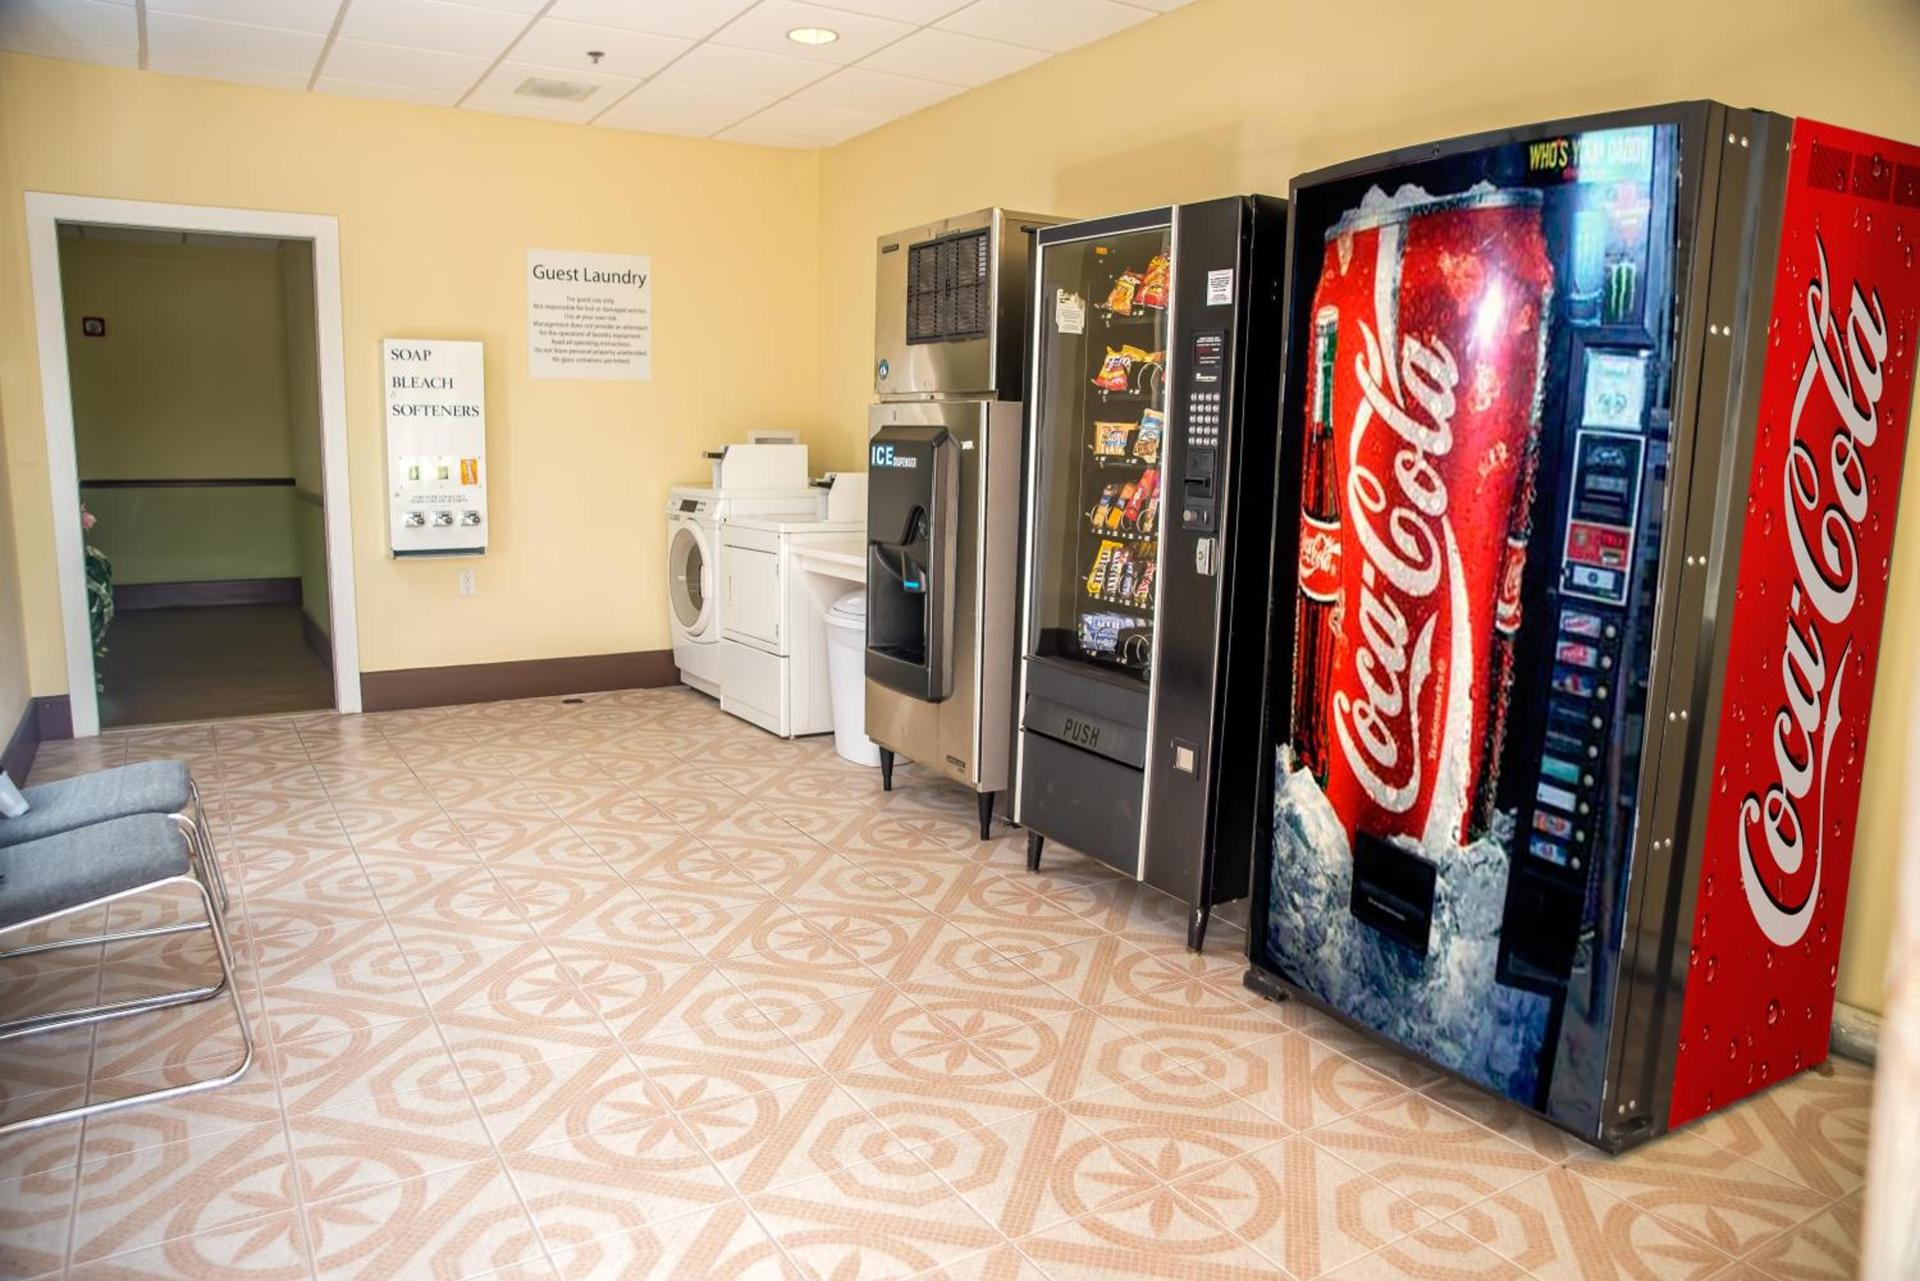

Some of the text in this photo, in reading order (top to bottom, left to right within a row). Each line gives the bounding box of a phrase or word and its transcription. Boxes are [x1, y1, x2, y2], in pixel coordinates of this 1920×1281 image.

[533, 264, 647, 289] Guest Laundry
[391, 348, 432, 361] SOAP
[392, 376, 454, 389] BLEACH
[392, 404, 480, 417] SOFTENERS
[872, 445, 893, 465] ICE
[1333, 318, 1460, 813] Coca-Cola
[1739, 230, 1888, 947] Coca-Cola
[1064, 717, 1100, 748] PUSH
